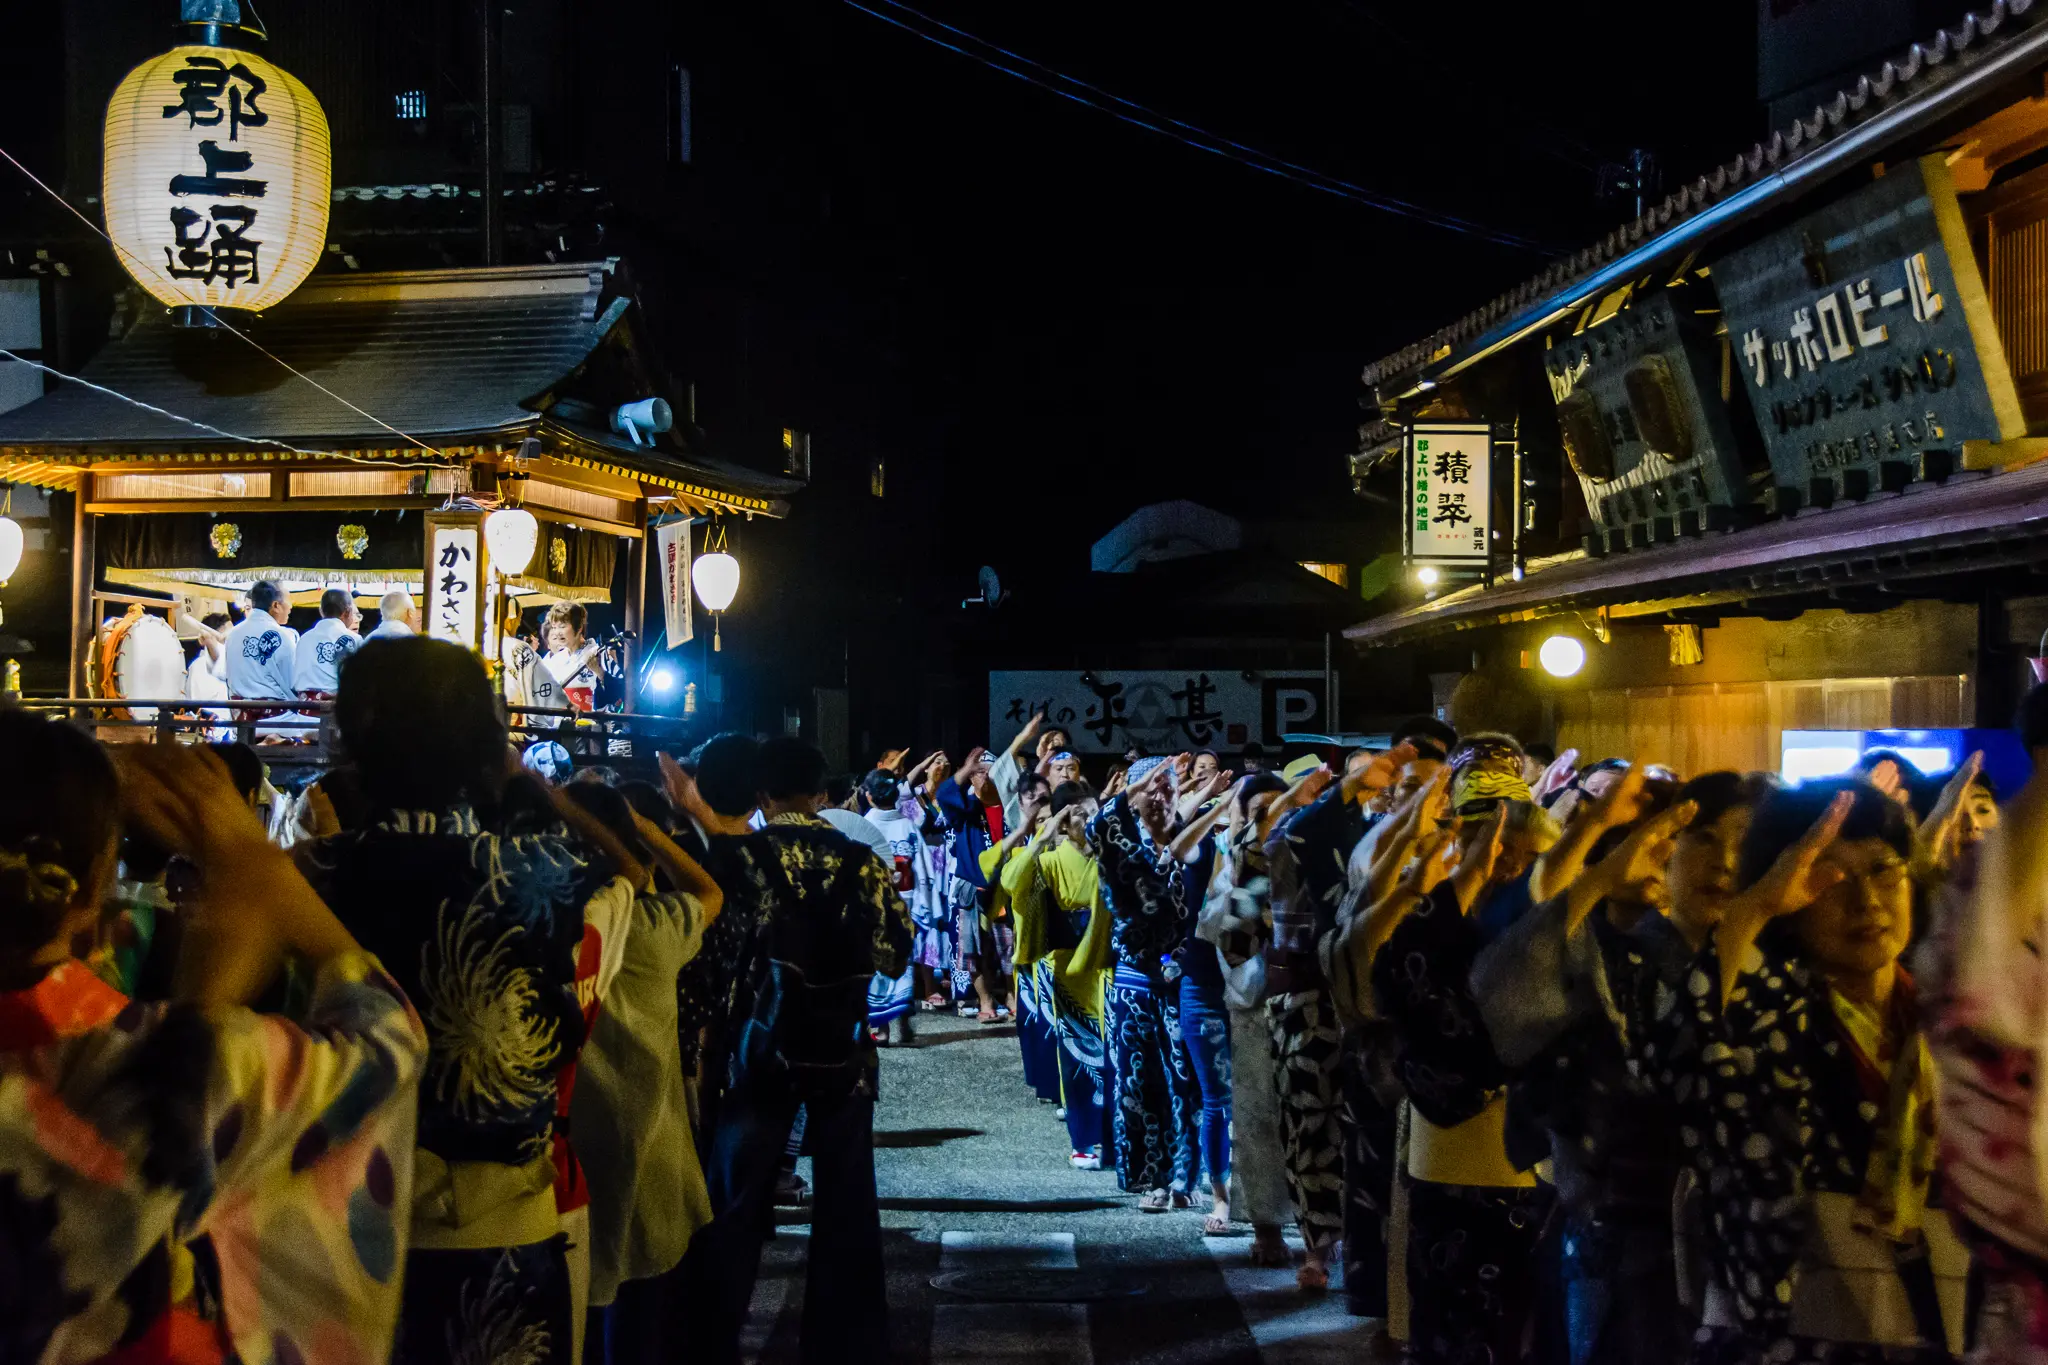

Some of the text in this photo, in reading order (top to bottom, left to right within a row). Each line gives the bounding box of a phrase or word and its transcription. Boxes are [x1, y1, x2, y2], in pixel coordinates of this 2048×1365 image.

[163, 57, 269, 288] 郡上踊
[1743, 252, 1943, 387] サッポロビール
[1416, 440, 1428, 531] 郡上八幡の地酒
[1432, 450, 1472, 528] 積翠
[1474, 527, 1485, 550] 蔵元
[1004, 697, 1077, 725] そばの
[1276, 688, 1320, 738] P
